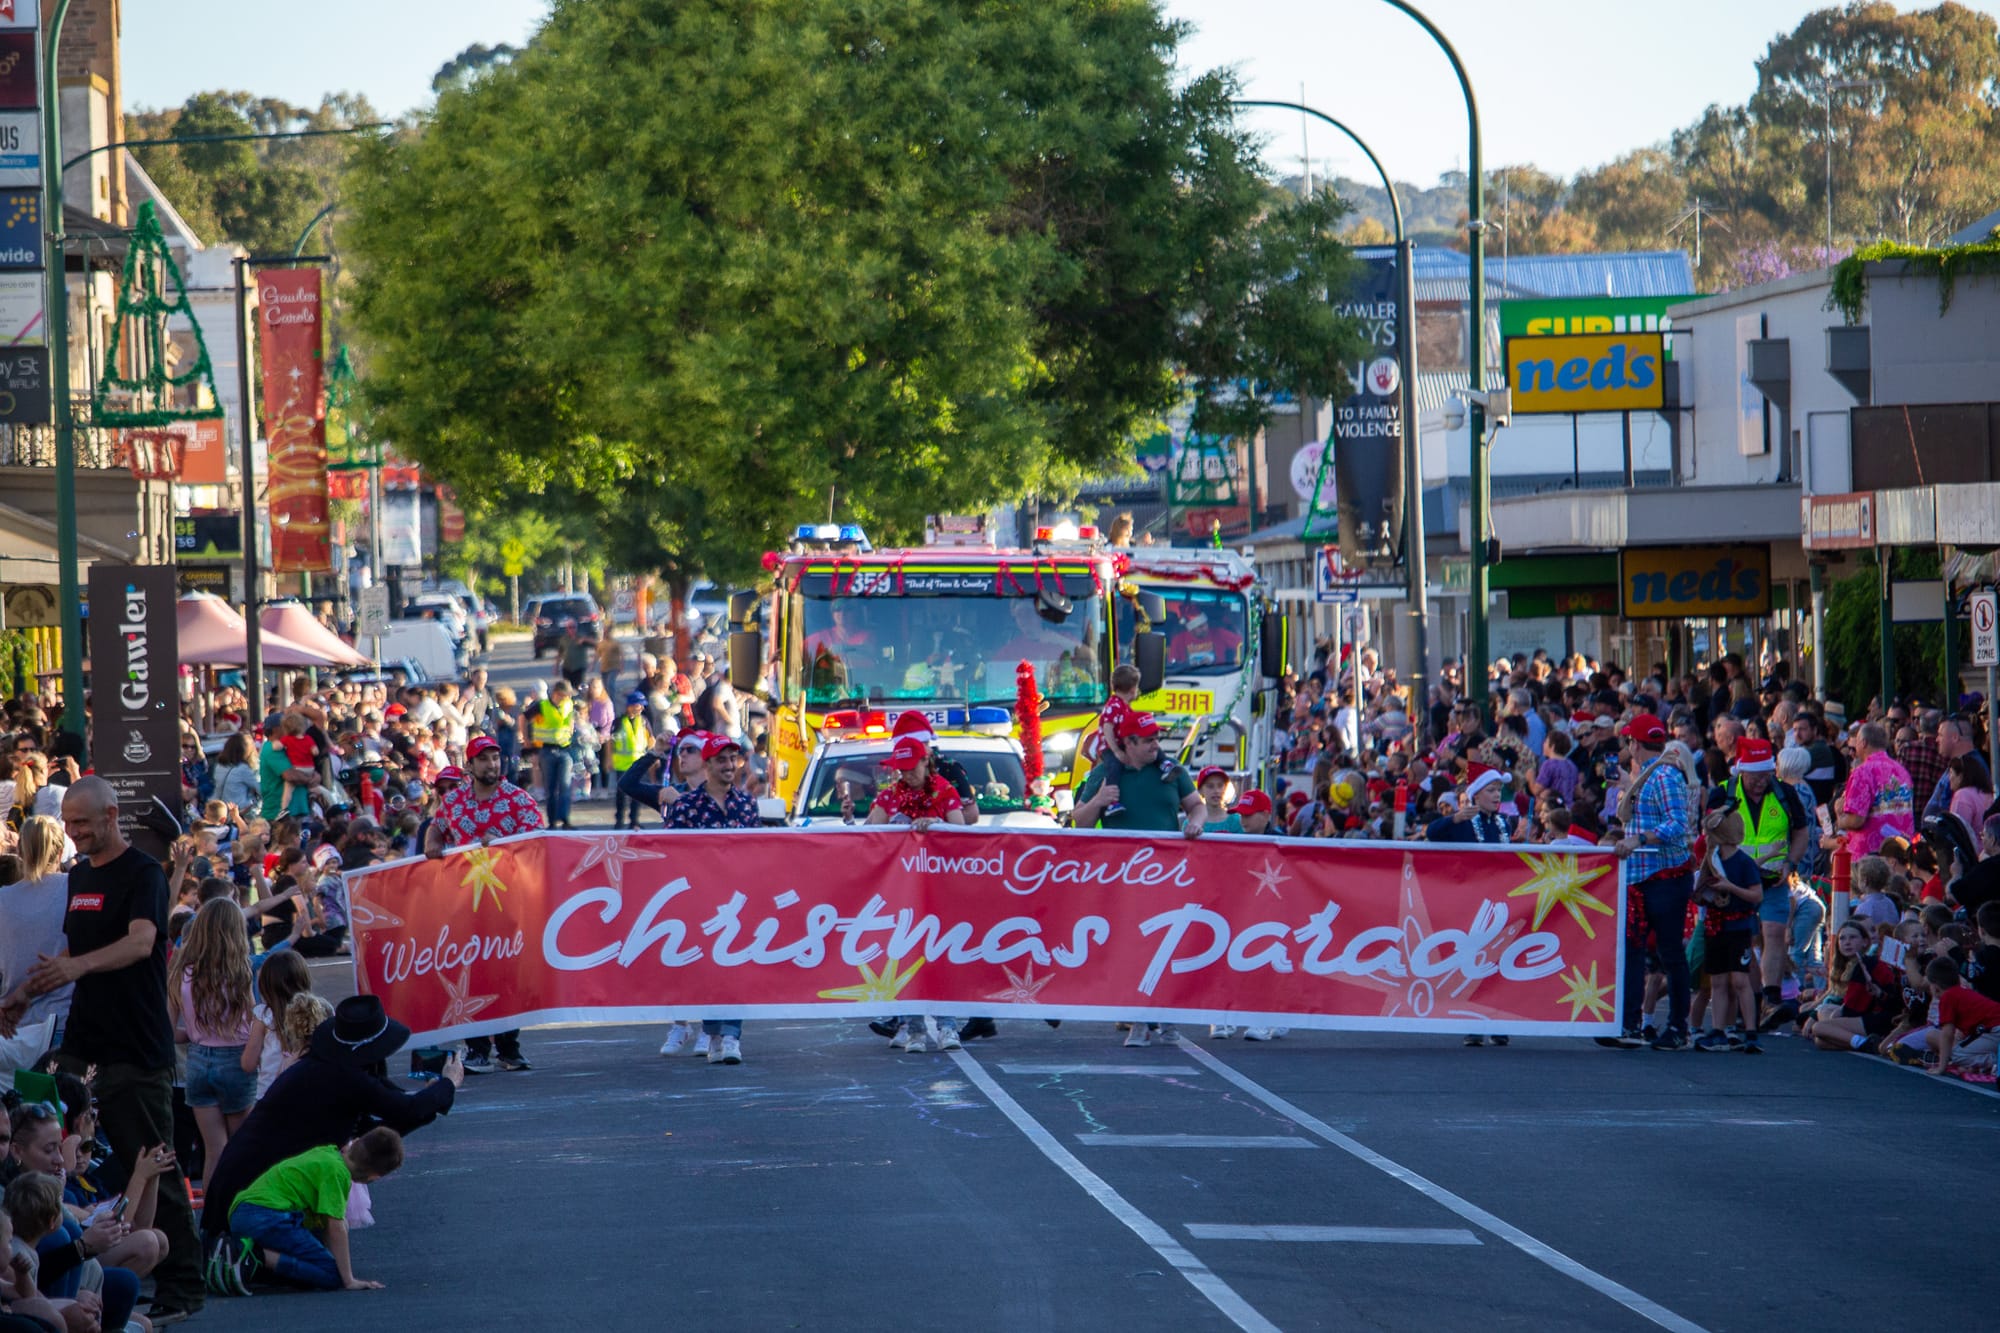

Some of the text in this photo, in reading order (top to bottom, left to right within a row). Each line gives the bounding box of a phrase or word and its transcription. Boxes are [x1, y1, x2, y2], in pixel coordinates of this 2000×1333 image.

[262, 285, 318, 304] Gawler
[265, 304, 316, 325] Carols
[1515, 343, 1656, 394] ned's
[1338, 406, 1399, 421] TO FAMILY
[1336, 420, 1402, 438] VIOLENCE
[851, 572, 891, 594] 359
[1630, 558, 1761, 604] ned's
[119, 584, 150, 711] Gawler
[1978, 635, 1992, 646] DRY
[1976, 648, 1995, 660] ZONE
[889, 712, 944, 724] PCE
[901, 844, 1195, 895] villawood Gawler
[542, 876, 1566, 998] Christmas Parade
[382, 924, 525, 984] Welcome
